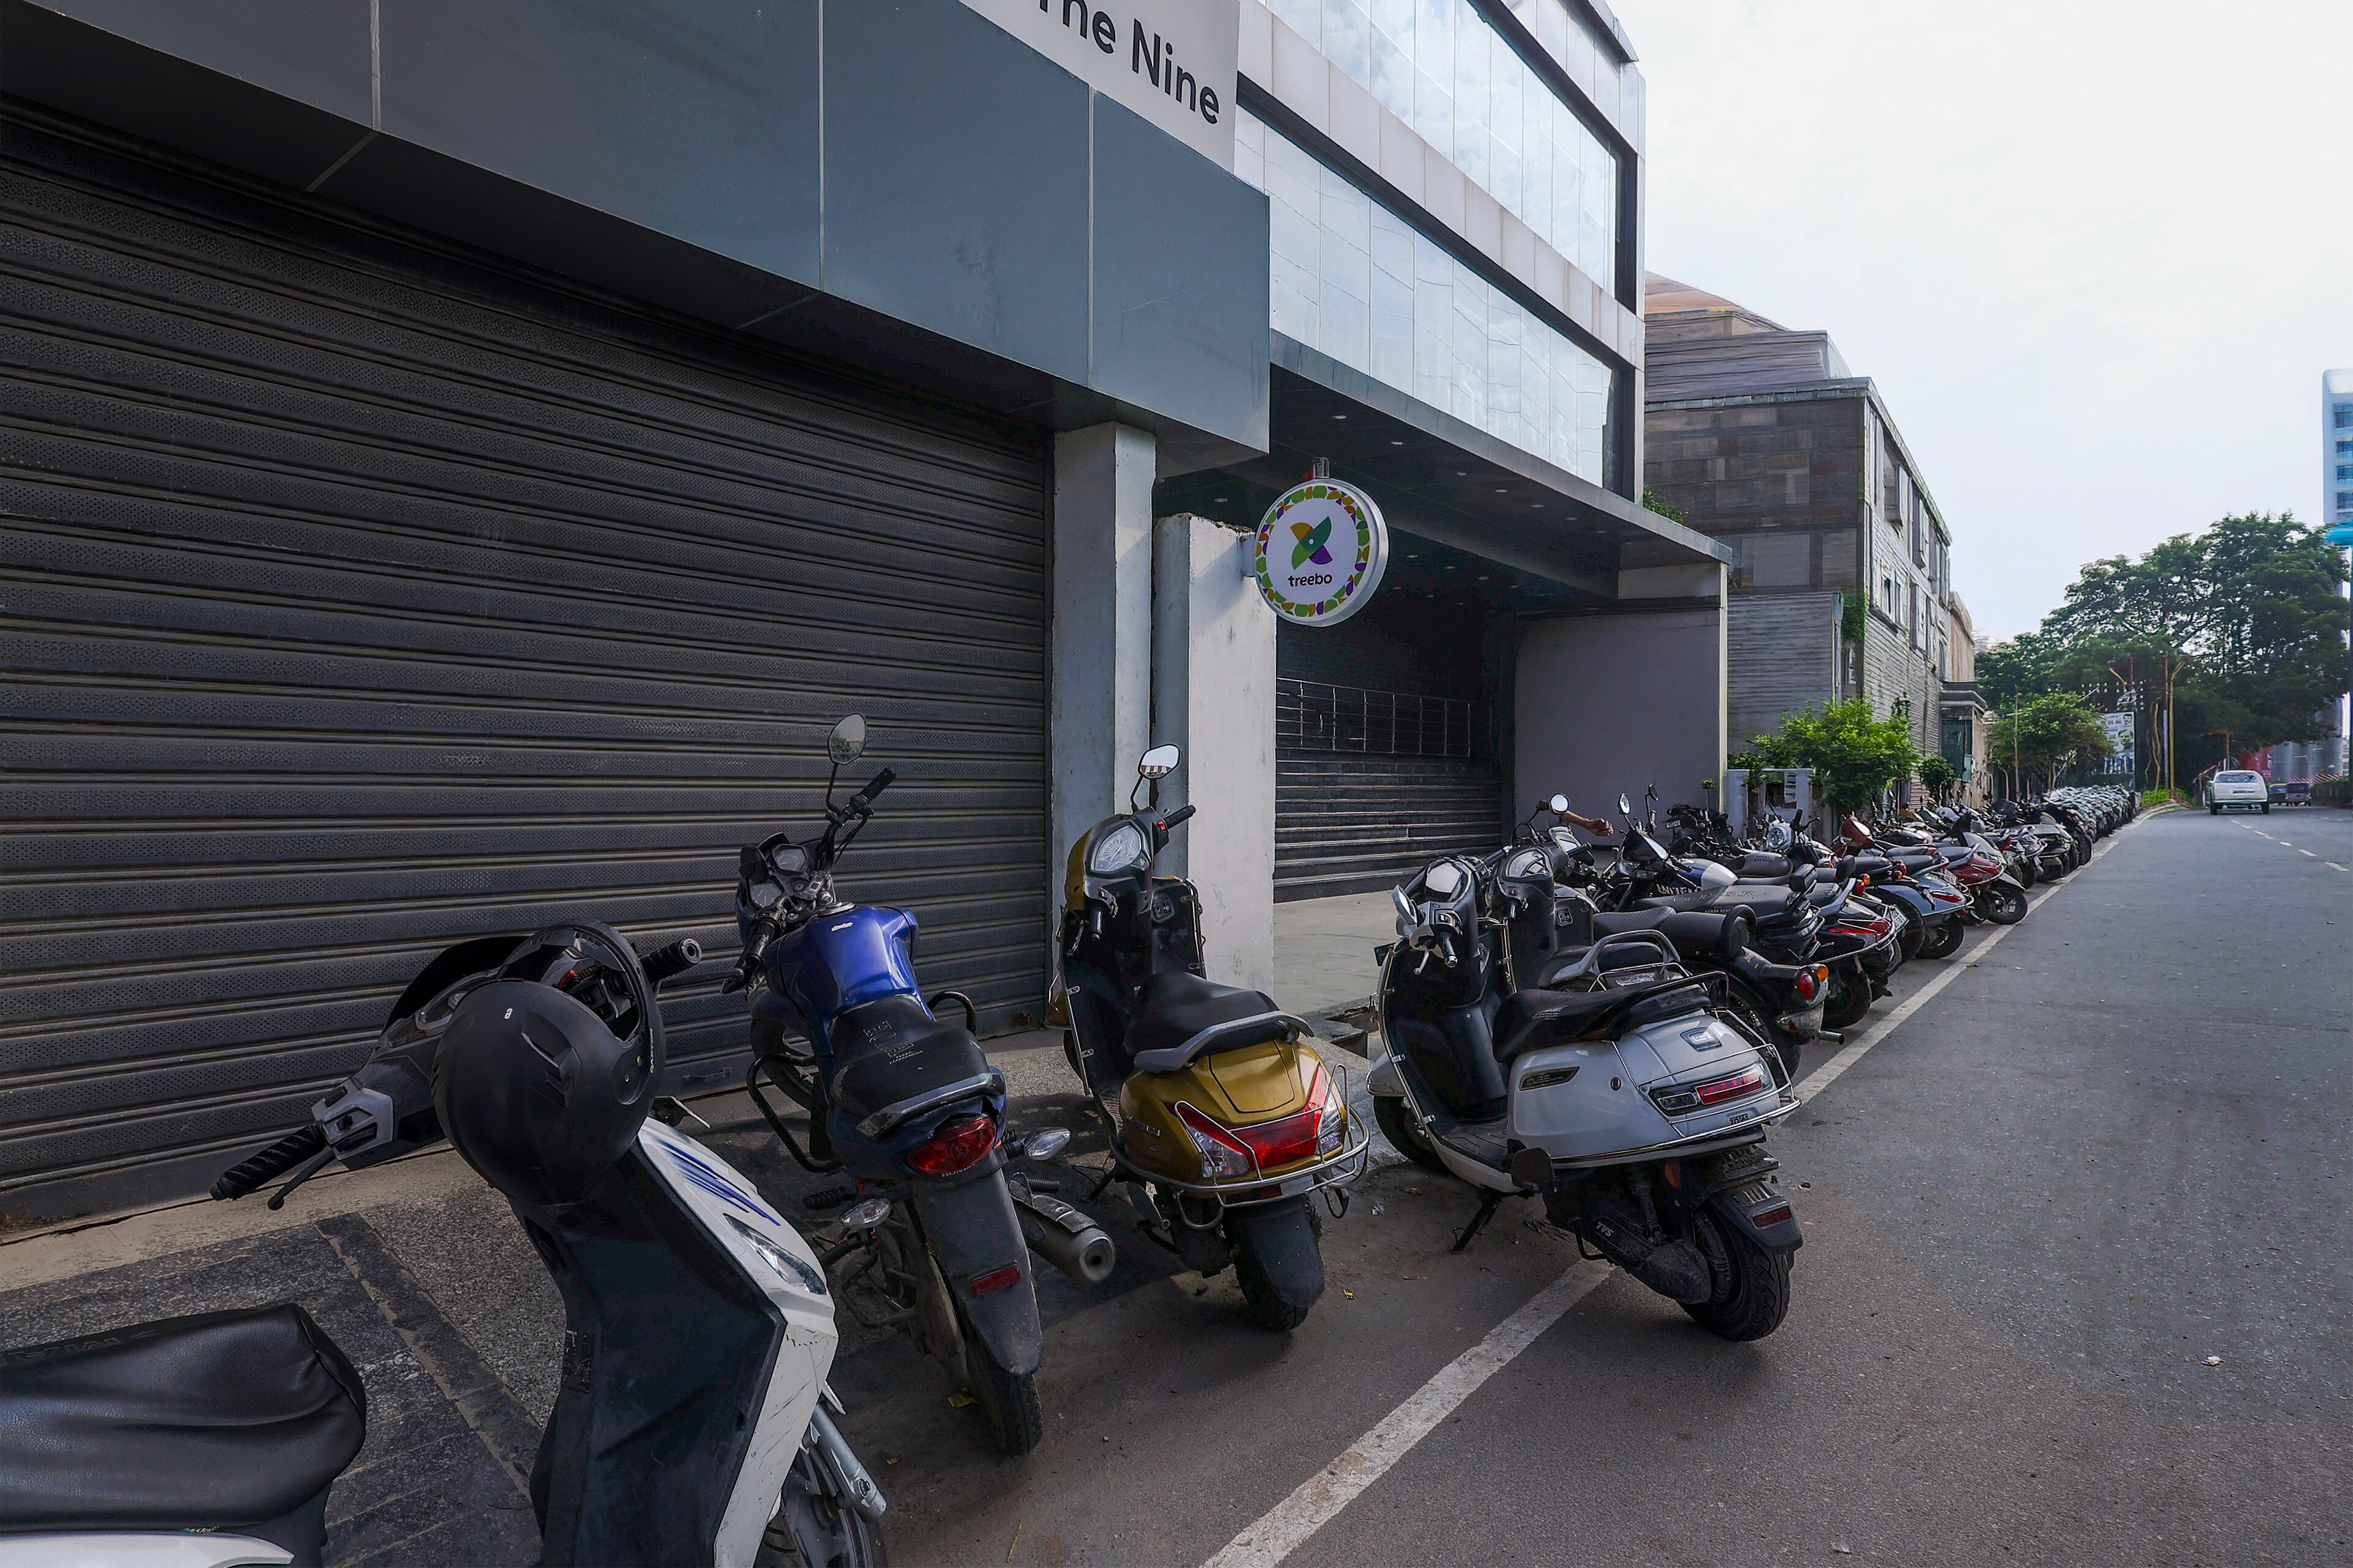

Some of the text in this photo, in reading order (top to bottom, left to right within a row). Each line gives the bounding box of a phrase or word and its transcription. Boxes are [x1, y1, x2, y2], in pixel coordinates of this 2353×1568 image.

[1039, 0, 1221, 125] he Nine
[1288, 573, 1333, 587] treebo
[1730, 1113, 1749, 1125] TVS
[1596, 1221, 1615, 1237] TVS
